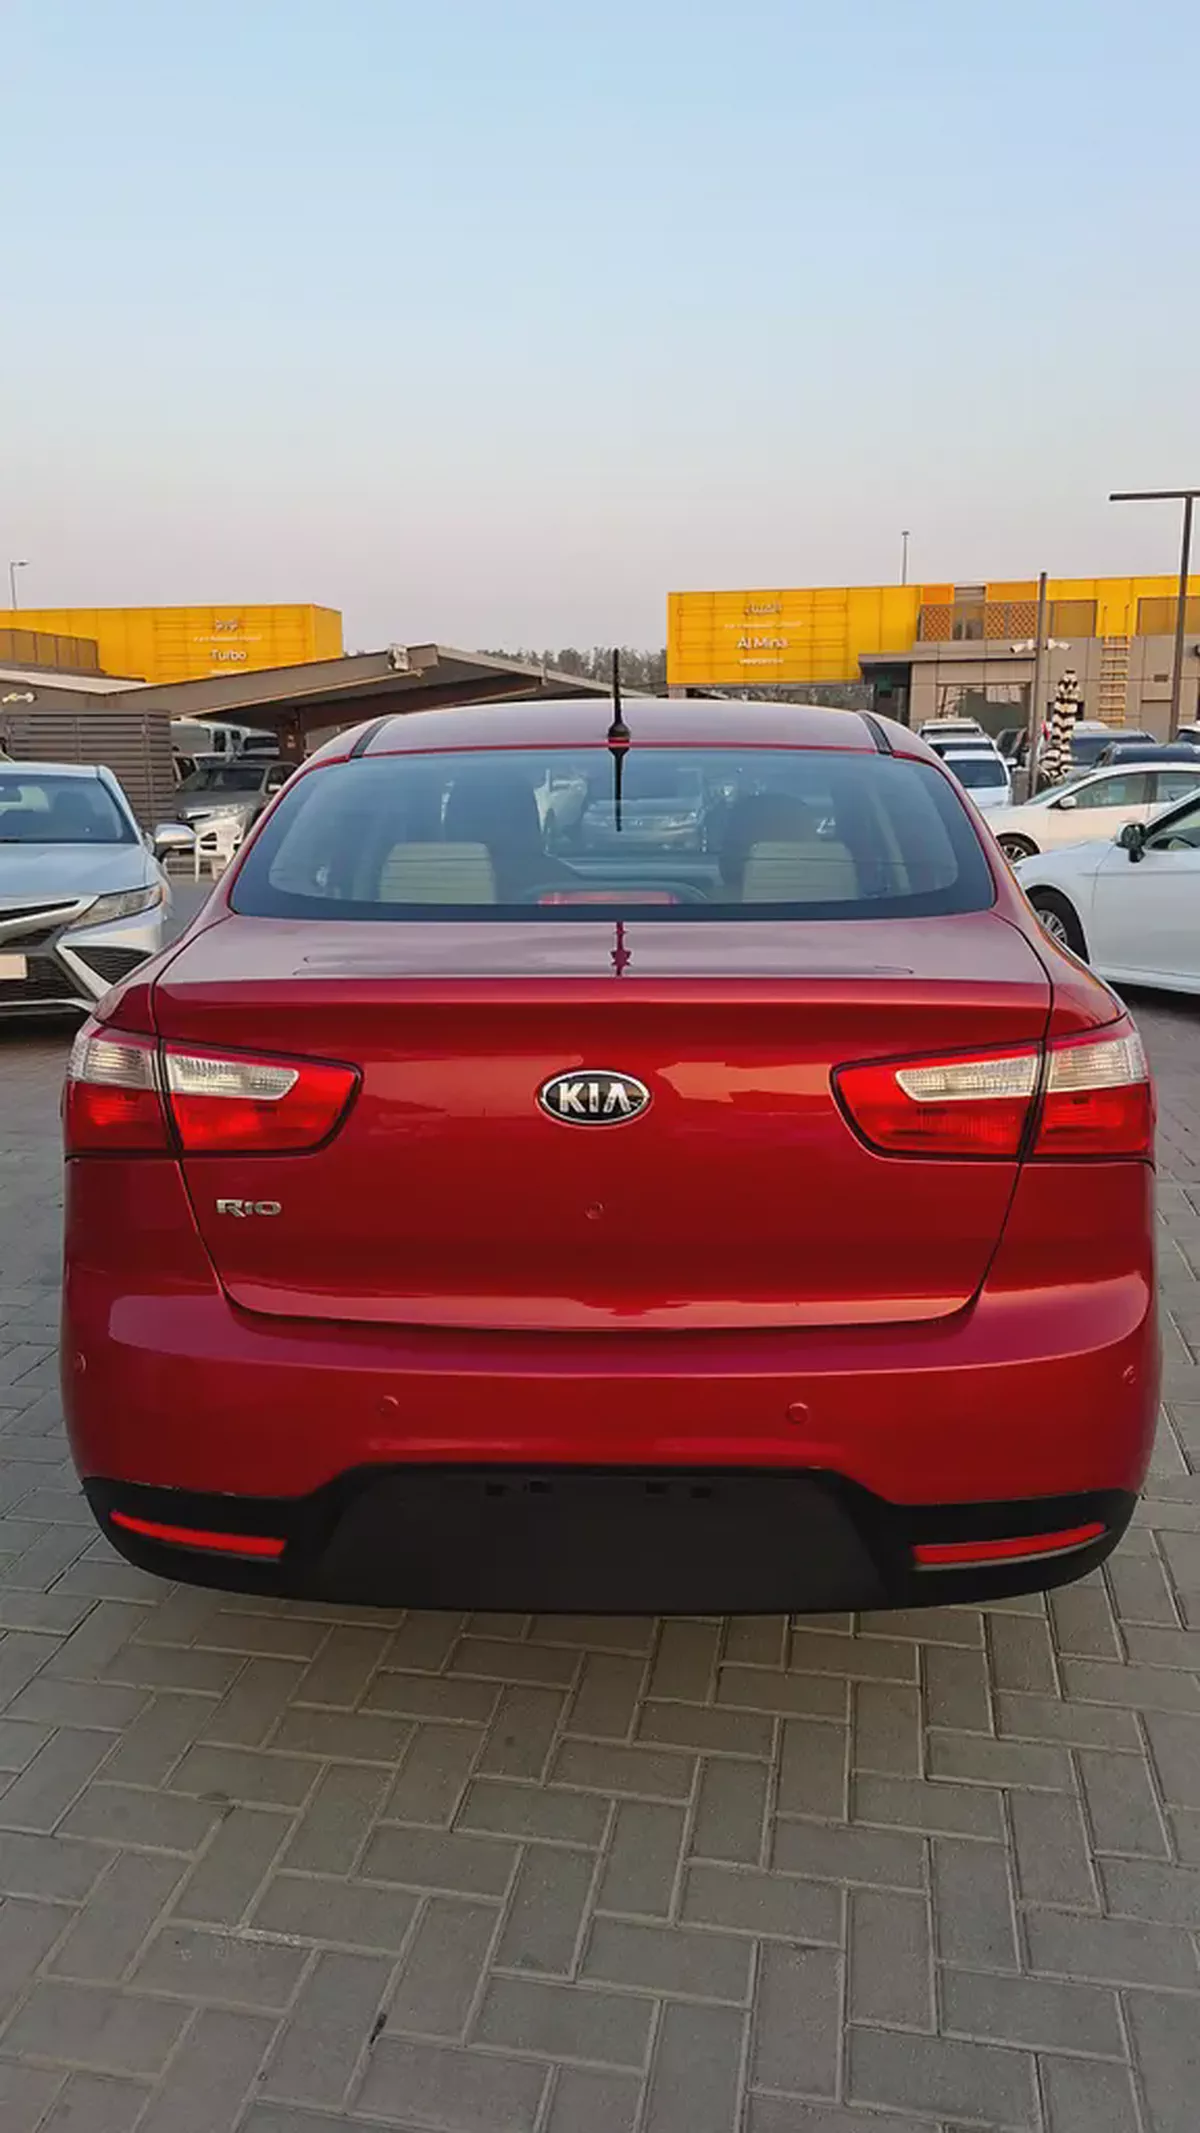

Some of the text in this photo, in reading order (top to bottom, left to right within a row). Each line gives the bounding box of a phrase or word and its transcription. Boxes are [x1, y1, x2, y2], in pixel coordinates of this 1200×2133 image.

[737, 636, 751, 649] Al
[211, 649, 247, 661] Turbo
[558, 1083, 632, 1113] KIA
